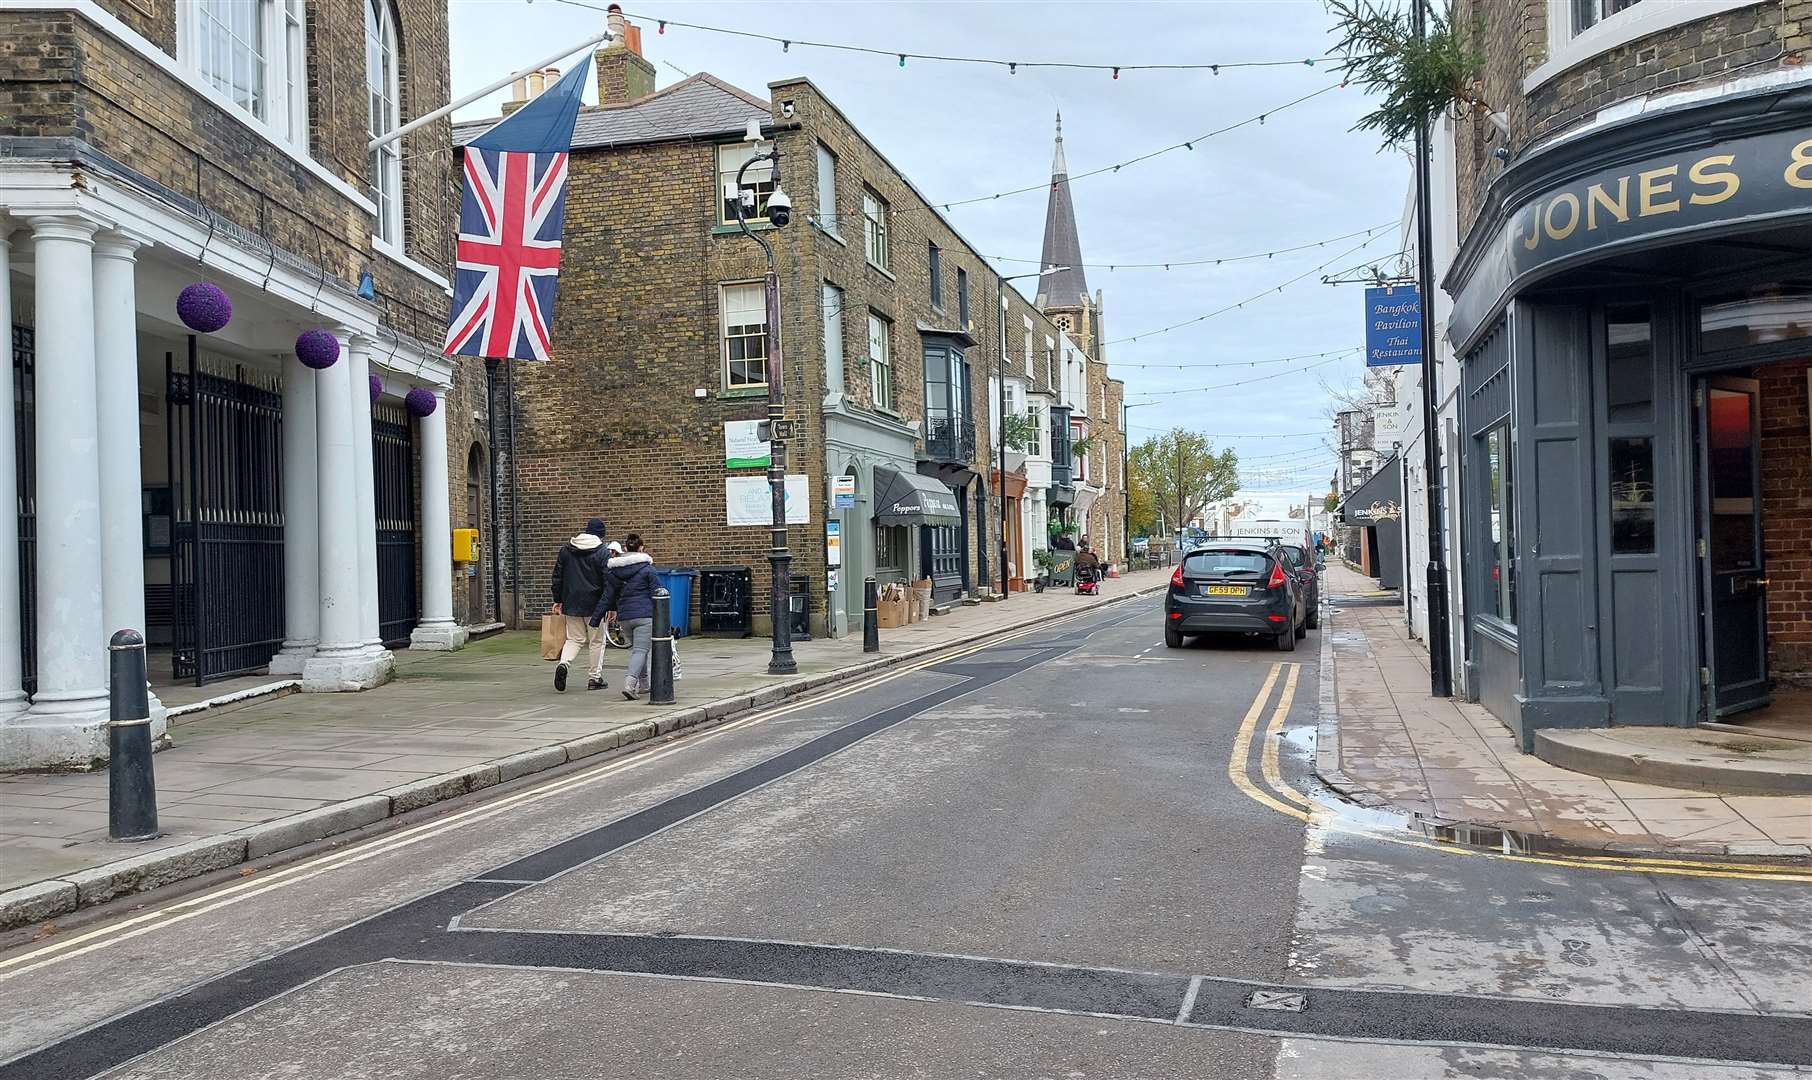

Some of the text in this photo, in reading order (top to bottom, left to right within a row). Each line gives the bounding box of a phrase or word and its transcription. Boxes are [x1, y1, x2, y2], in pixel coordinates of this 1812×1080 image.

[1524, 153, 1741, 250] JONES
[1374, 300, 1421, 317] Bangkok
[1375, 318, 1418, 330] Pavilion
[1386, 335, 1409, 346] Thai
[1237, 527, 1300, 535] JENKINS & SON
[1209, 586, 1229, 594] GF59
